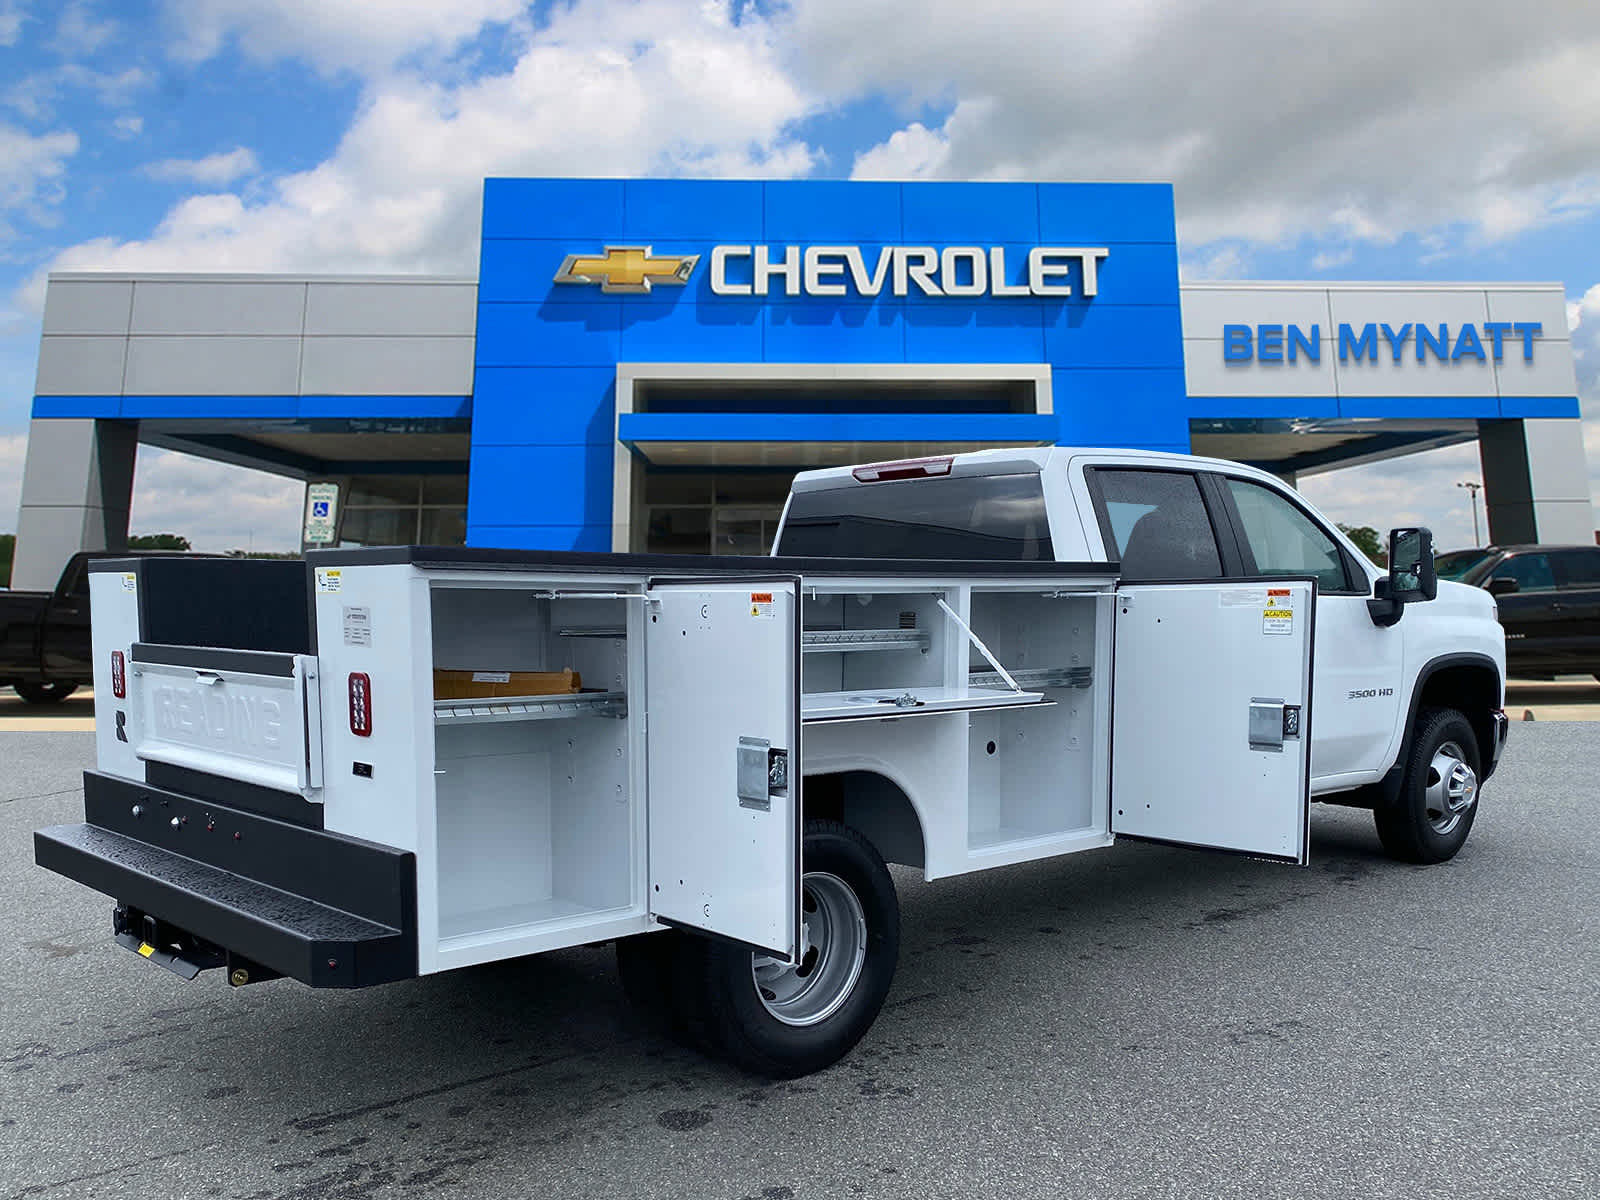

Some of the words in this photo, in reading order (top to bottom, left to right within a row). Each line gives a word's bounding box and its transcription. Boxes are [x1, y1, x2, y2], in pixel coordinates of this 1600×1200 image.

[711, 245, 1110, 296] CHEVROLET
[1223, 324, 1321, 363] BEN
[1338, 322, 1543, 363] MYNATT
[1269, 610, 1293, 618] CAUTION
[1348, 690, 1376, 699] 3500
[1378, 688, 1393, 696] HD
